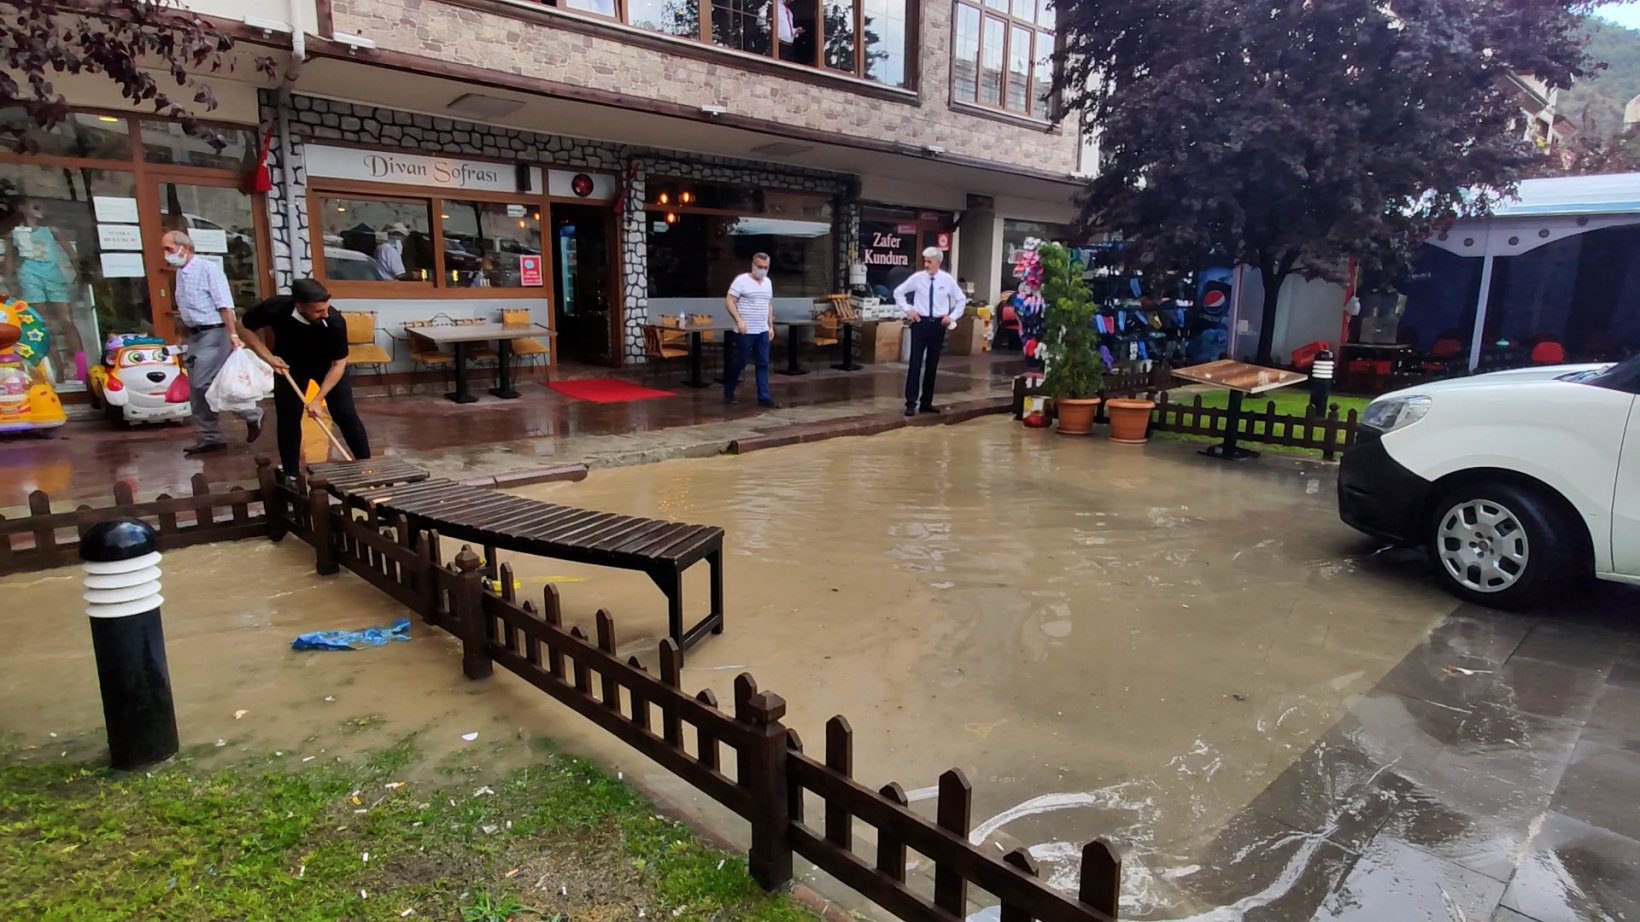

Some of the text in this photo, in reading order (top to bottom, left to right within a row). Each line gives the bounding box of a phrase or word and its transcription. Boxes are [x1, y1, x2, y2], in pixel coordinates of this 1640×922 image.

[363, 155, 498, 187] Divan Sofrası
[872, 232, 902, 248] Zafer
[864, 249, 909, 266] Kundura
